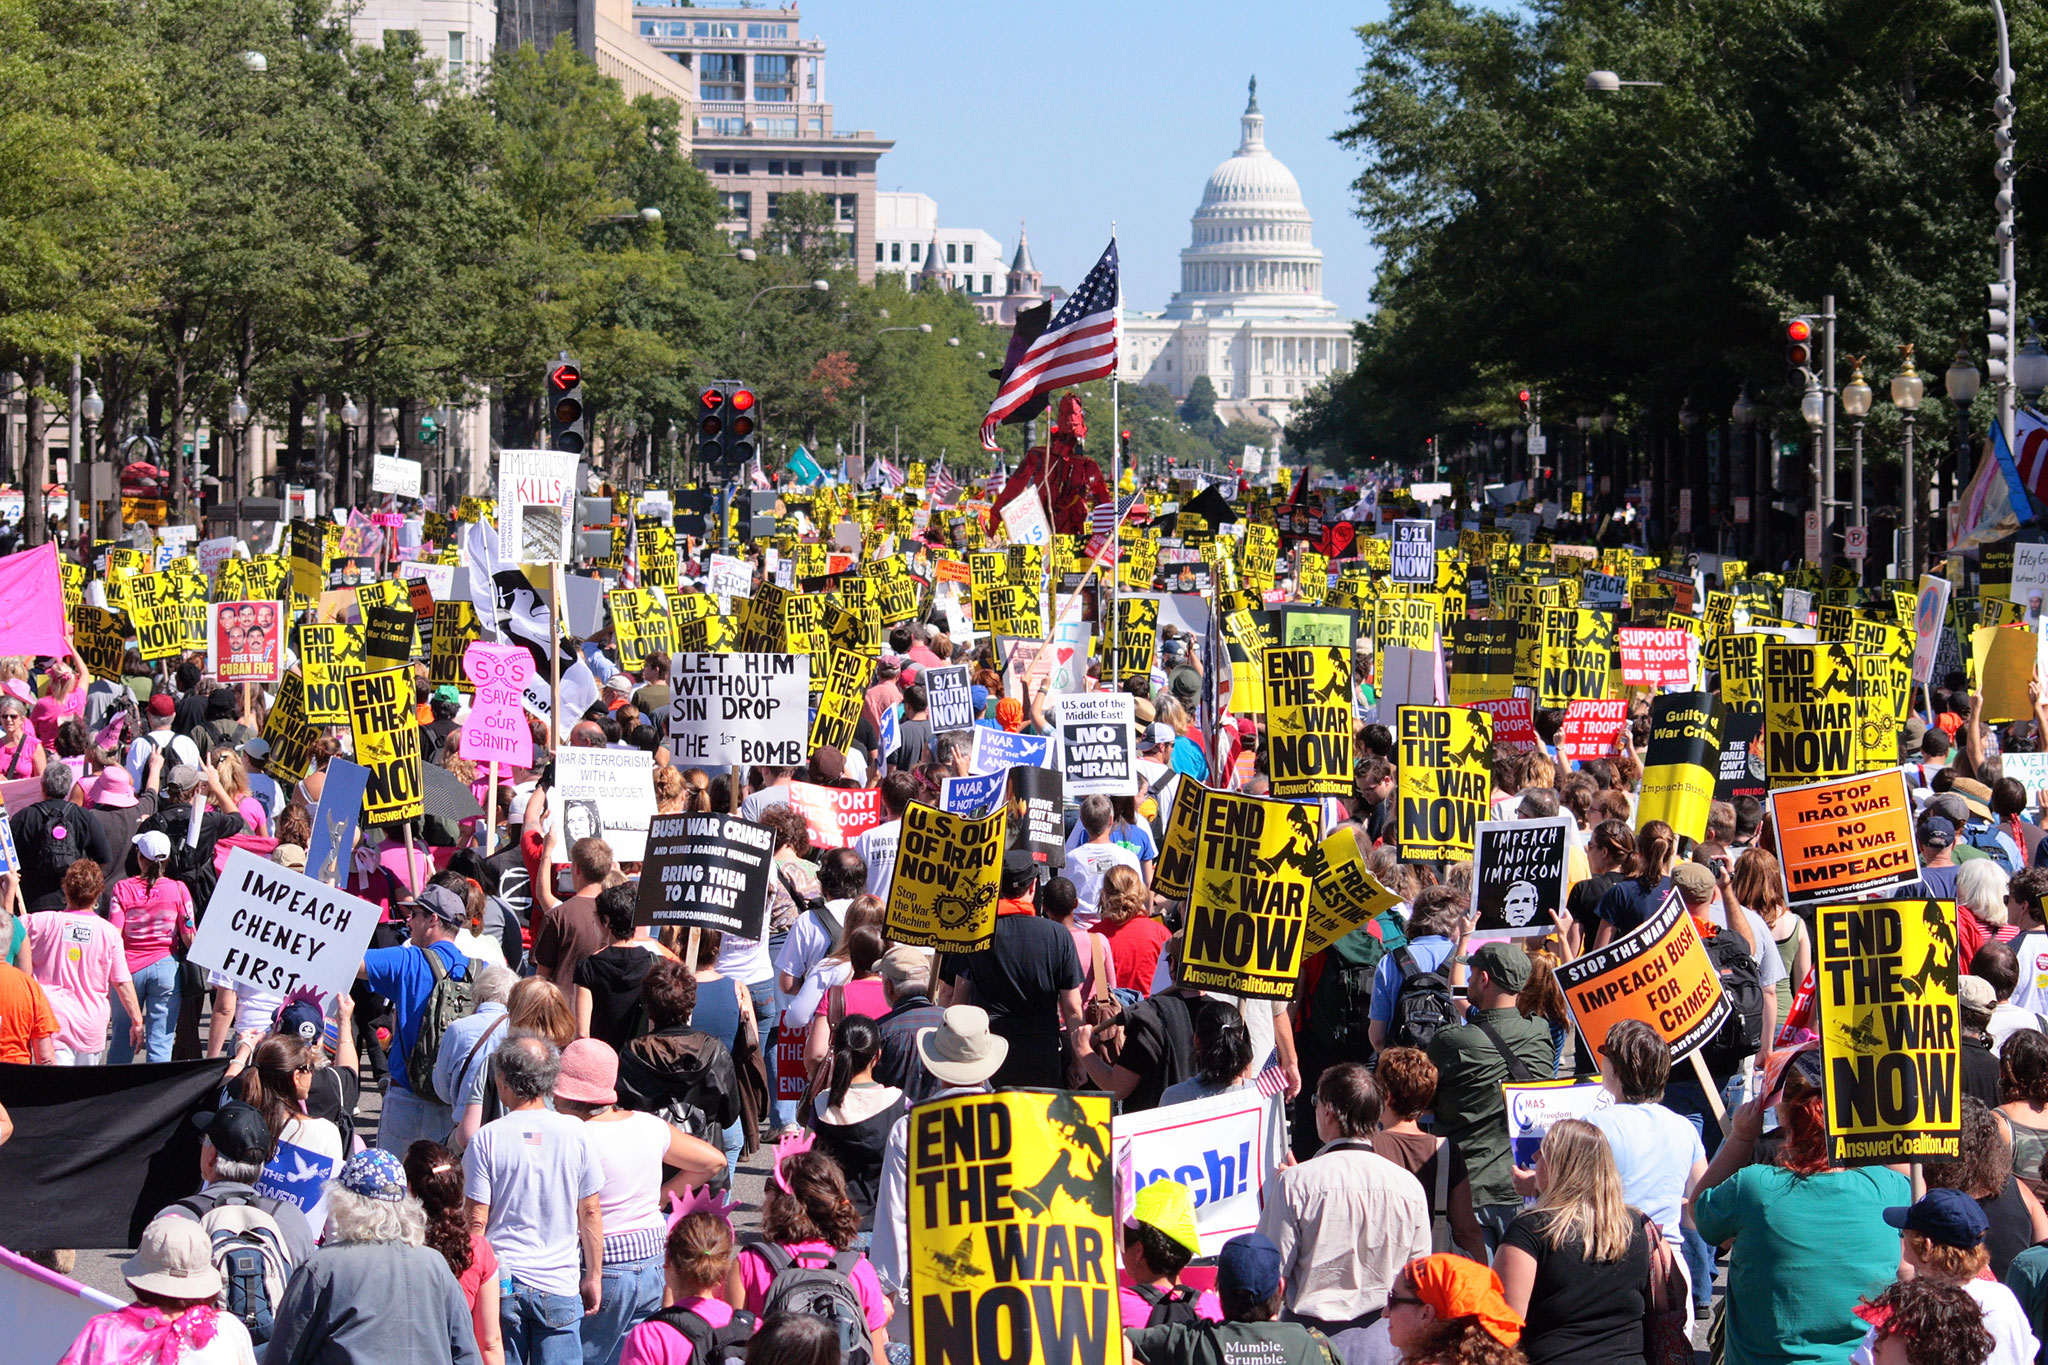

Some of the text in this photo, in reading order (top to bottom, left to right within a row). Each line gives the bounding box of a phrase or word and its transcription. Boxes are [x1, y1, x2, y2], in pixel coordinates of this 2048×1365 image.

[517, 478, 561, 503] KILLS
[1009, 499, 1034, 524] BUSH
[637, 531, 658, 542] END
[1250, 526, 1266, 537] END
[1401, 529, 1426, 542] 9/11
[639, 543, 658, 555] THE
[1249, 537, 1265, 546] THE
[1396, 543, 1430, 557] TRUTH
[201, 546, 231, 559] Screw
[654, 555, 675, 567] WAR
[1259, 547, 1274, 558] WAR
[1244, 557, 1273, 573] NOW
[1395, 559, 1430, 577] NOW
[132, 578, 155, 593] END
[640, 568, 675, 587] NOW
[133, 591, 158, 607] THE
[153, 605, 178, 620] WAR
[139, 620, 180, 646] NOW
[373, 619, 405, 632] Guilty of
[367, 630, 410, 643] War Crimes
[1464, 633, 1506, 642] Guilty of
[1621, 630, 1683, 646] SUPPORT
[231, 654, 263, 663] FREE THE
[1456, 645, 1512, 655] War Crimes
[1623, 649, 1685, 661] THE TROOPS
[220, 662, 274, 675] CUBAN FIVE
[681, 654, 724, 674] LET
[1268, 650, 1314, 678] END
[934, 673, 960, 690] 9/11
[1624, 669, 1687, 680] END THE WAR
[673, 675, 774, 696] WITHOUT
[1269, 679, 1316, 706] THE
[481, 689, 518, 707] SAVE
[930, 687, 969, 706] TRUTH
[1062, 700, 1126, 710] U.S. out of the
[672, 698, 780, 722] SIN DROP
[934, 703, 970, 727] NOW
[1066, 711, 1123, 720] Middle East!
[485, 716, 515, 731] OUR
[1303, 706, 1348, 734] WAR
[1666, 710, 1719, 730] Guilty of
[469, 729, 518, 753] SANITY
[986, 734, 1013, 749] WAR
[1076, 727, 1116, 743] NO
[1654, 727, 1720, 751] War Crimes
[672, 733, 801, 764] THE BOMB
[988, 747, 1004, 758] NOT
[1071, 744, 1122, 762] WAR
[1730, 741, 1746, 751] THE
[558, 754, 650, 770] WAR IS TERRORISM
[1273, 737, 1349, 777] NOW
[1720, 761, 1746, 771] CAN'T
[581, 770, 616, 782] WITH A
[1068, 762, 1127, 777] ON IRAN
[1719, 770, 1746, 780] WAIT!
[561, 786, 644, 799] BIGGER BUDGET
[1274, 782, 1352, 796] AnswerCoalition.org
[1818, 784, 1871, 805] STOP
[1029, 798, 1053, 811] DRIVE
[1798, 796, 1890, 824] IRAQ WAR
[1029, 809, 1062, 824] OUT THE
[1206, 798, 1265, 840] END
[651, 818, 684, 839] BUSH
[687, 819, 720, 838] WAR
[723, 821, 772, 851] CRIMES
[908, 807, 1005, 846] U.S. OUT
[1029, 820, 1052, 833] BUSH
[1837, 822, 1866, 838] NO
[1029, 829, 1063, 846] REGIME!
[1493, 827, 1559, 847] IMPEACH
[1803, 831, 1896, 858] IRAN WAR
[653, 845, 762, 867] AND CRIMES AGAINST HUMANITY
[906, 831, 999, 869] OF IRAQ
[1205, 833, 1260, 878] THE
[1497, 847, 1551, 864] INDICT
[900, 857, 960, 892] NOW
[1484, 860, 1561, 883] IMPRISON
[1792, 849, 1909, 885] IMPEACH
[661, 865, 746, 892] BRING THEM
[1337, 859, 1380, 904] FREE
[1814, 875, 1899, 897] www.worldcantwait.org
[241, 870, 352, 933] IMPEACH
[665, 885, 738, 909] TO A HALT
[896, 885, 917, 901] Stop
[1240, 876, 1305, 918] WAR
[894, 899, 929, 916] the War
[652, 910, 743, 929] WWW.BUSHCOMMISSION.ORG
[892, 912, 931, 929] Machine
[231, 908, 327, 962] CHENEY
[886, 926, 991, 955] AnswerCoalition.org
[1189, 905, 1302, 973] NOW
[1569, 897, 1681, 982] STOP THE WAR NOW!
[1823, 908, 1903, 959] END
[223, 947, 302, 997] FIRST
[1577, 924, 1695, 1014] IMPEACH BUSH
[1183, 965, 1295, 998] AnswerCoalition.org
[1824, 956, 1904, 1007] THE
[1646, 977, 1682, 1012] FOR
[1659, 977, 1715, 1034] CRIMES!
[1881, 1004, 1954, 1051] WAR
[1833, 1051, 1957, 1129] NOW
[1525, 1099, 1545, 1109] MAS
[1540, 1111, 1572, 1119] Freedom
[916, 1102, 1012, 1170] END
[1835, 1131, 1959, 1159] AnswerCoalition.org
[916, 1161, 1015, 1229] THE
[984, 1223, 1108, 1284] WAR
[922, 1284, 1109, 1365] NOW
[1225, 1341, 1284, 1353] Mumble.
[1224, 1353, 1287, 1365] Grumble.
